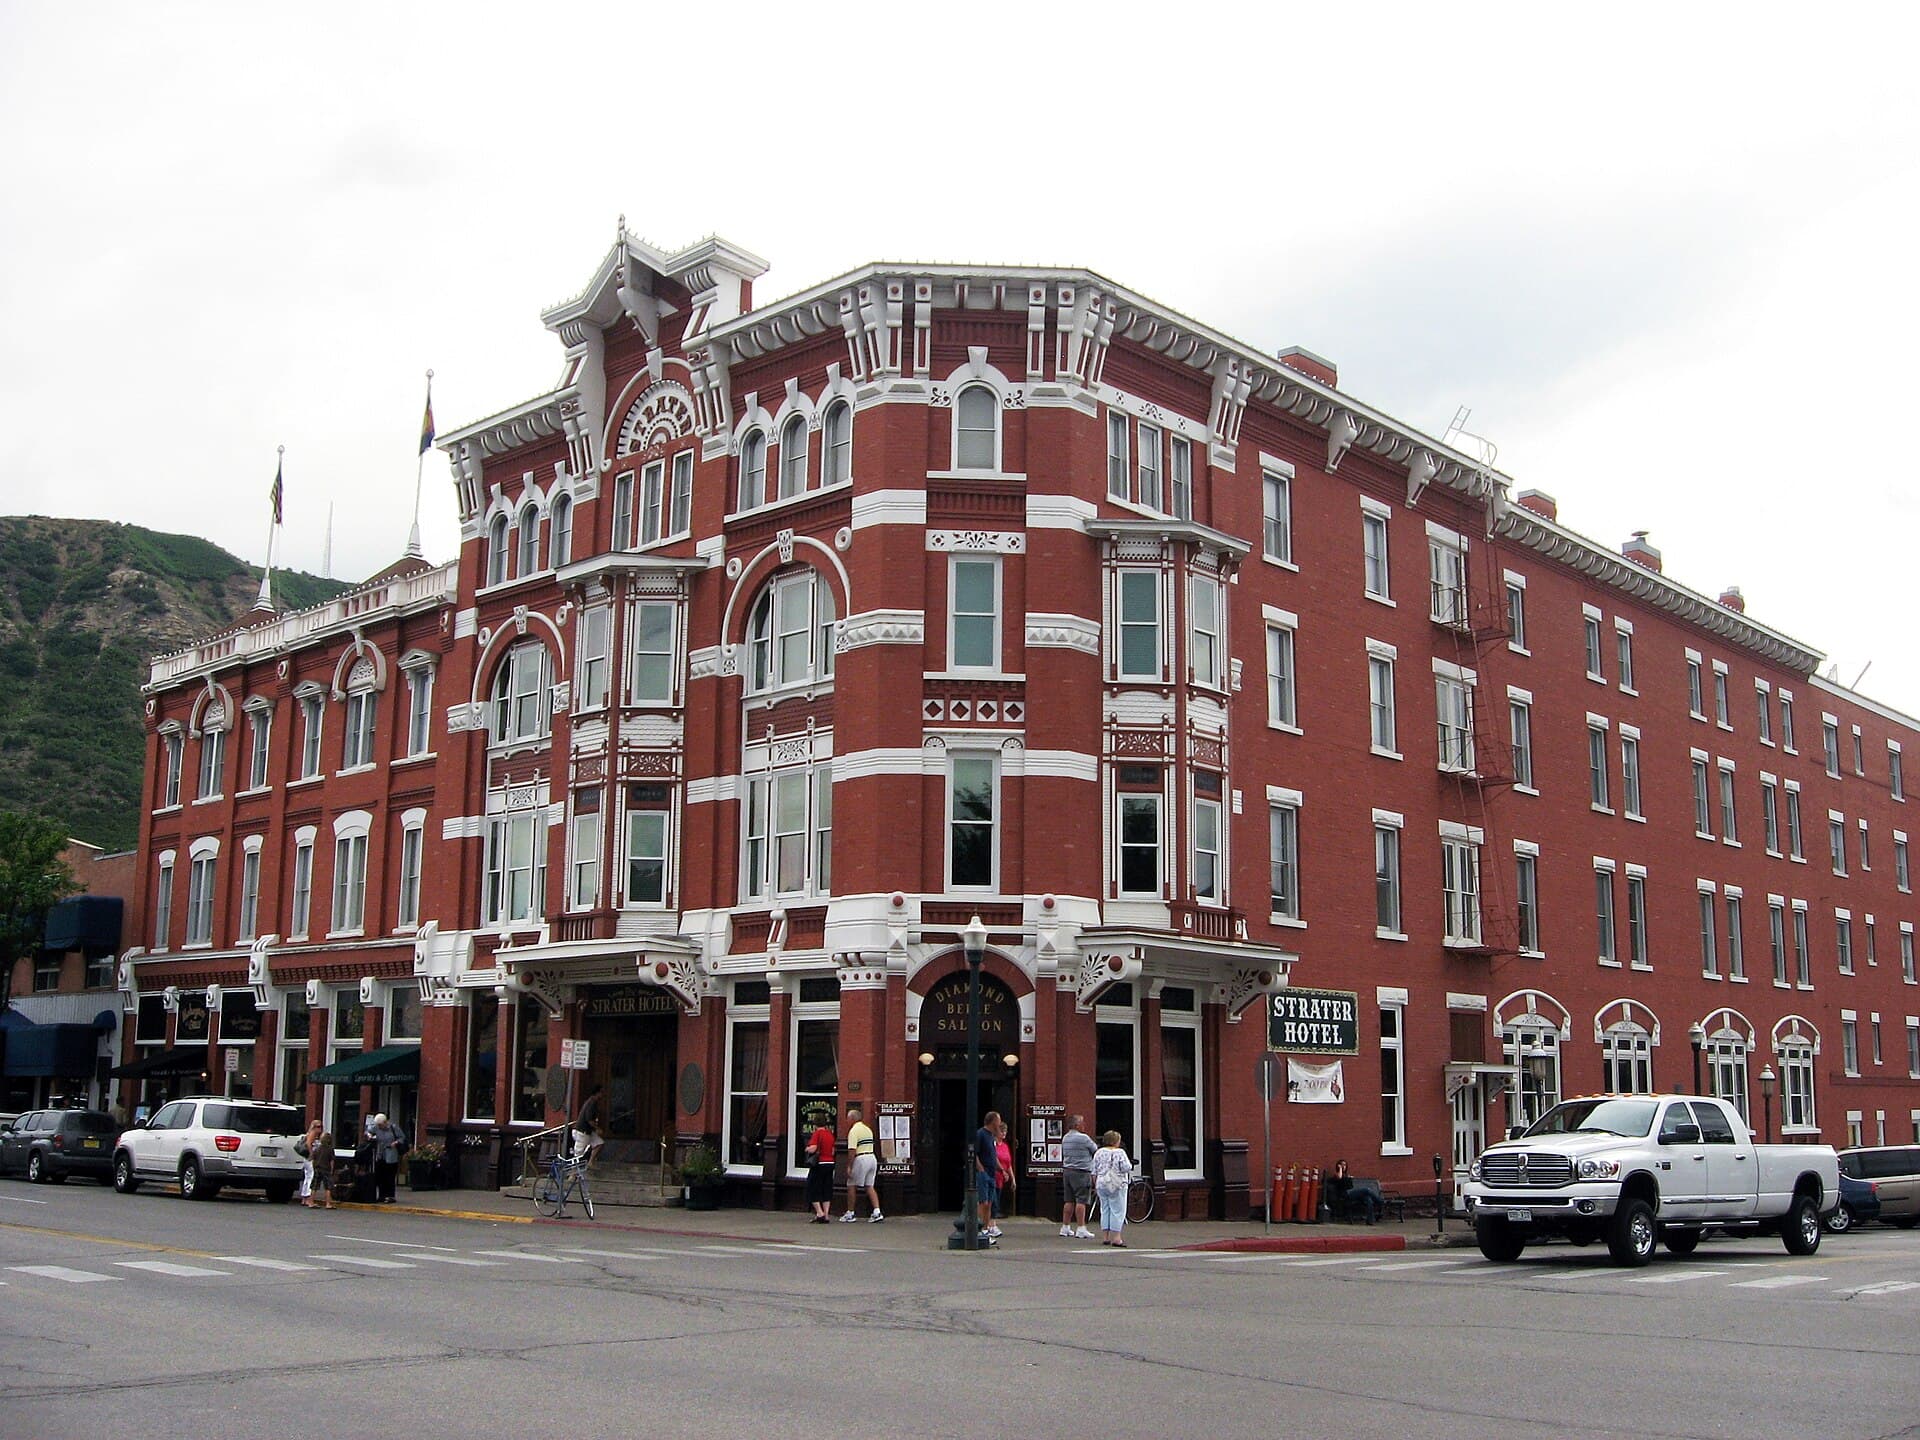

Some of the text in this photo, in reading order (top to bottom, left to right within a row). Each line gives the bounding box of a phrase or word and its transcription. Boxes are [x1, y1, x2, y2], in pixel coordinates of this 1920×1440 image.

[629, 396, 692, 452] STRATER
[592, 996, 672, 1014] STRATER HOTEL
[947, 1003, 991, 1015] BEE
[1274, 996, 1353, 1021] STRATER
[937, 1019, 1002, 1031] SALON
[1284, 1021, 1343, 1045] HOTEL
